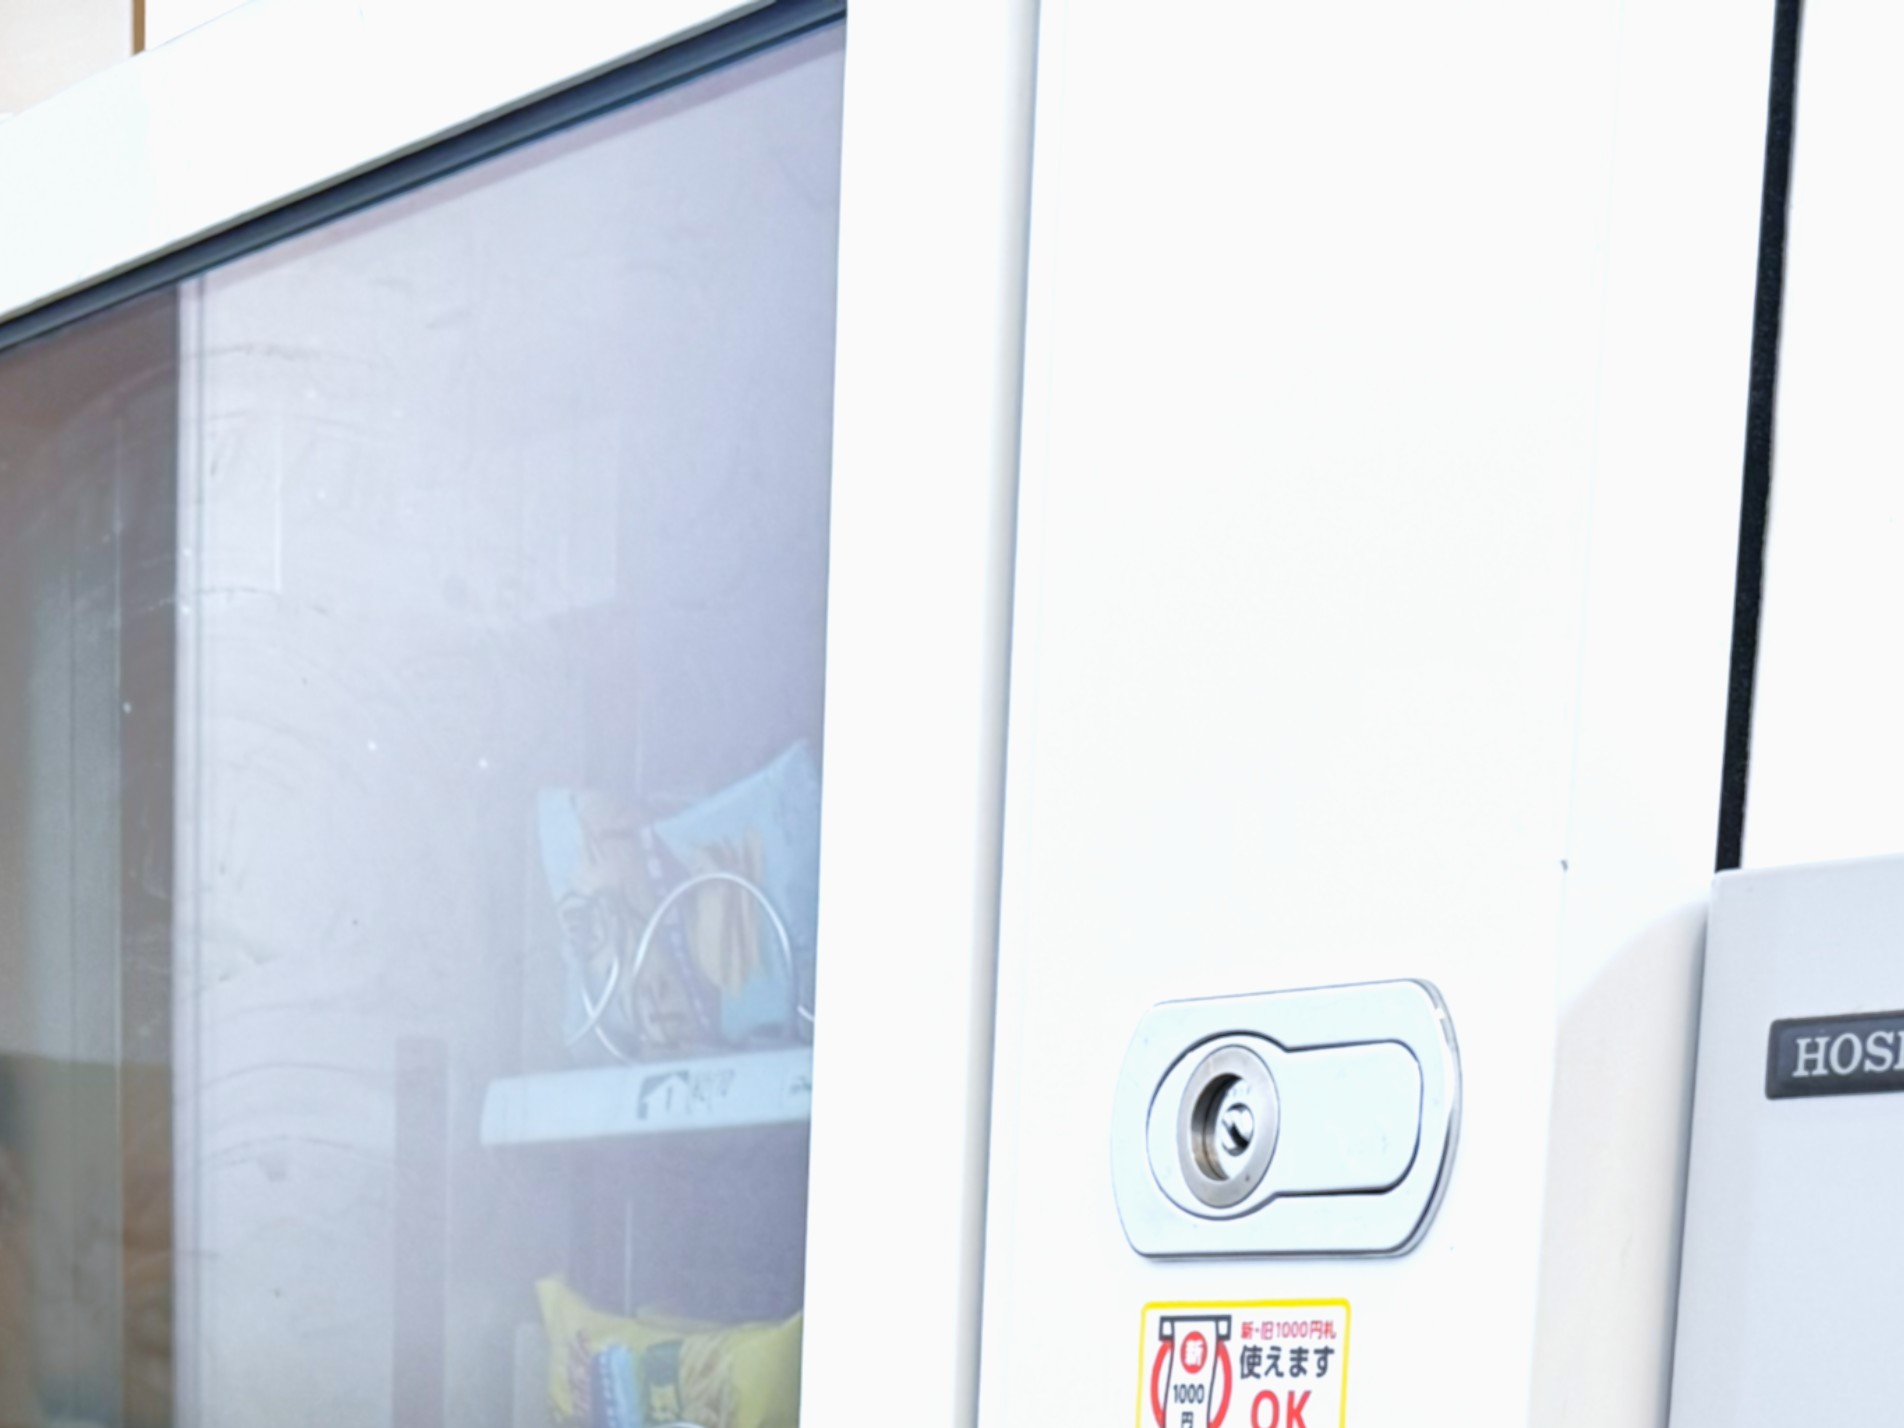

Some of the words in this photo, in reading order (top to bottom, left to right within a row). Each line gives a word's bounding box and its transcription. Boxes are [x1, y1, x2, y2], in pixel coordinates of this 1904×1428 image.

[1239, 1345, 1335, 1380] 使えます
[1172, 1384, 1205, 1408] 1000
